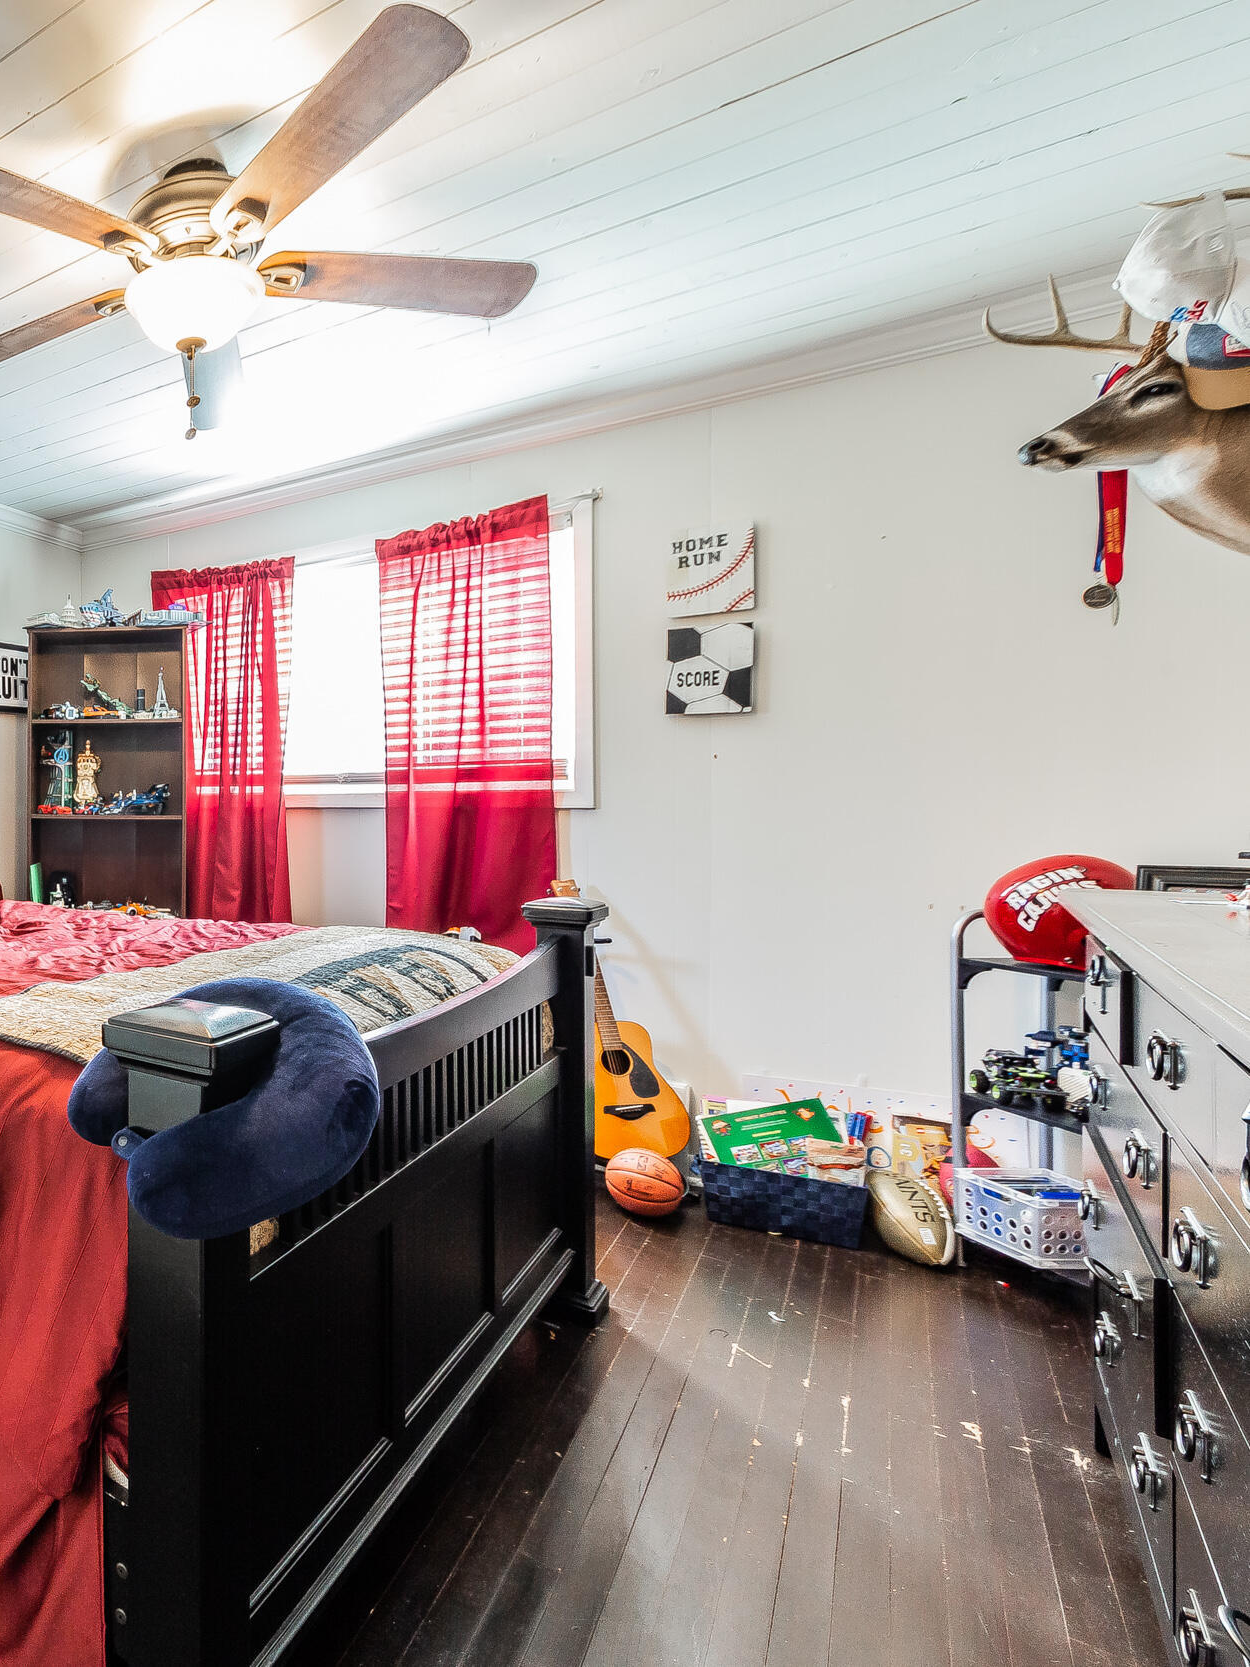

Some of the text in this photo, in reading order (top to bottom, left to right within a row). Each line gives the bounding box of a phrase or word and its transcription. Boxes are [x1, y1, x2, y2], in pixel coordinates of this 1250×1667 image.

[671, 533, 728, 554] HOME
[678, 550, 721, 569] RUN
[676, 669, 720, 687] SCORE
